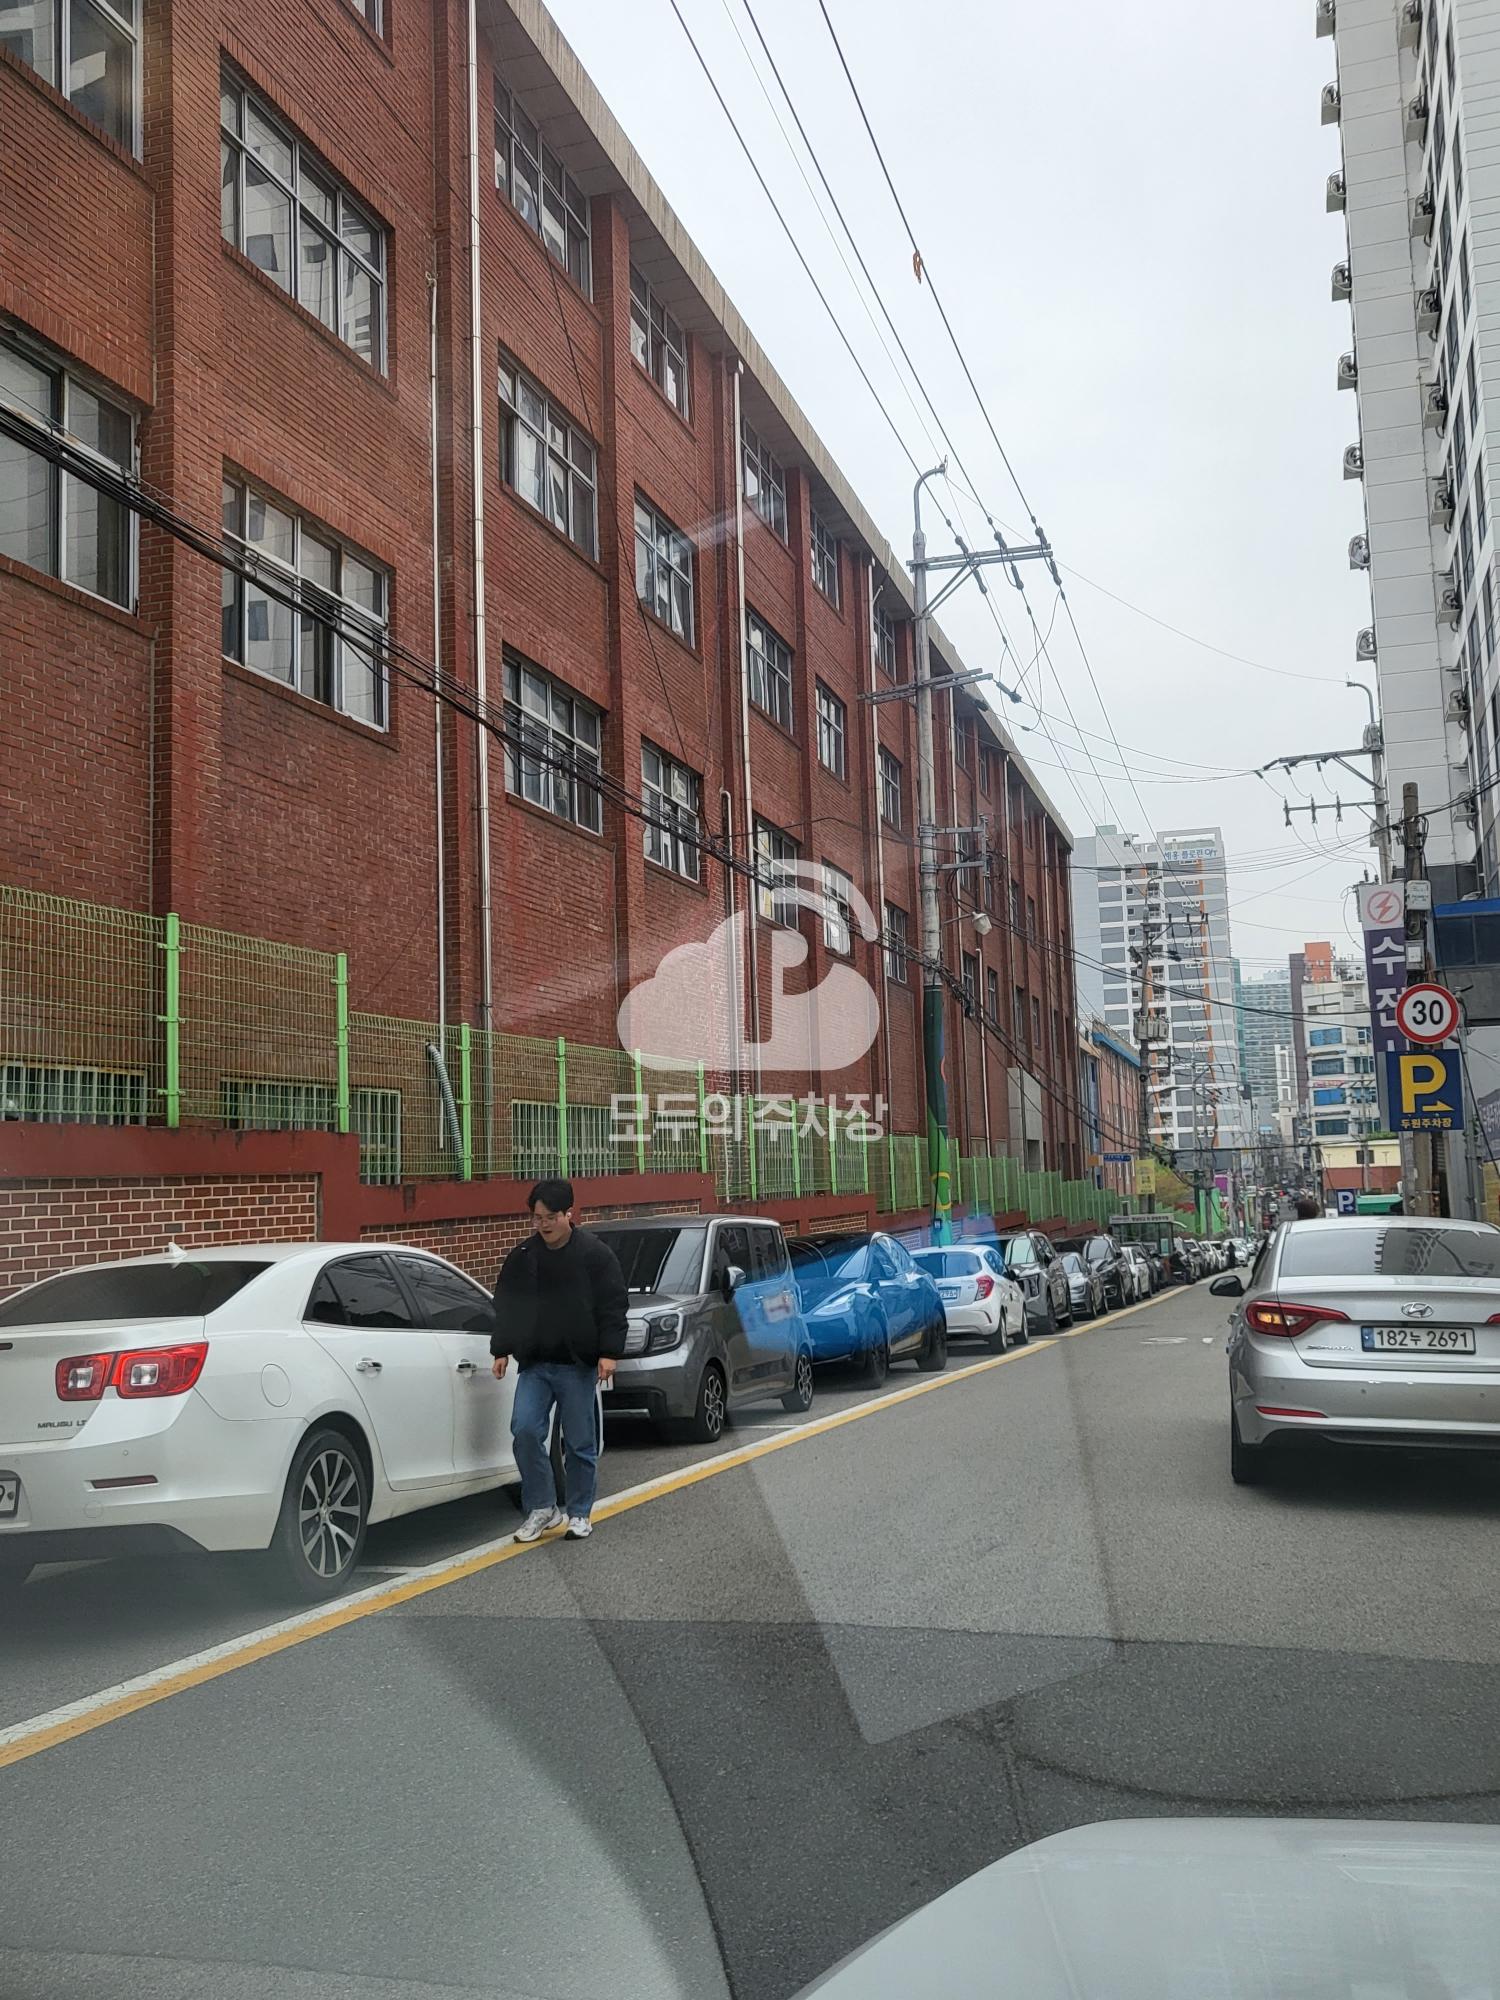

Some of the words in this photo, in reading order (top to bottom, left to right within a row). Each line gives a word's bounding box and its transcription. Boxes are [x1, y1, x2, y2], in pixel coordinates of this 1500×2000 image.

[1412, 999, 1444, 1026] 30
[1399, 1054, 1447, 1114] P
[1337, 1191, 1354, 1212] P
[1376, 1329, 1422, 1347] 182누
[1426, 1331, 1469, 1348] 2691
